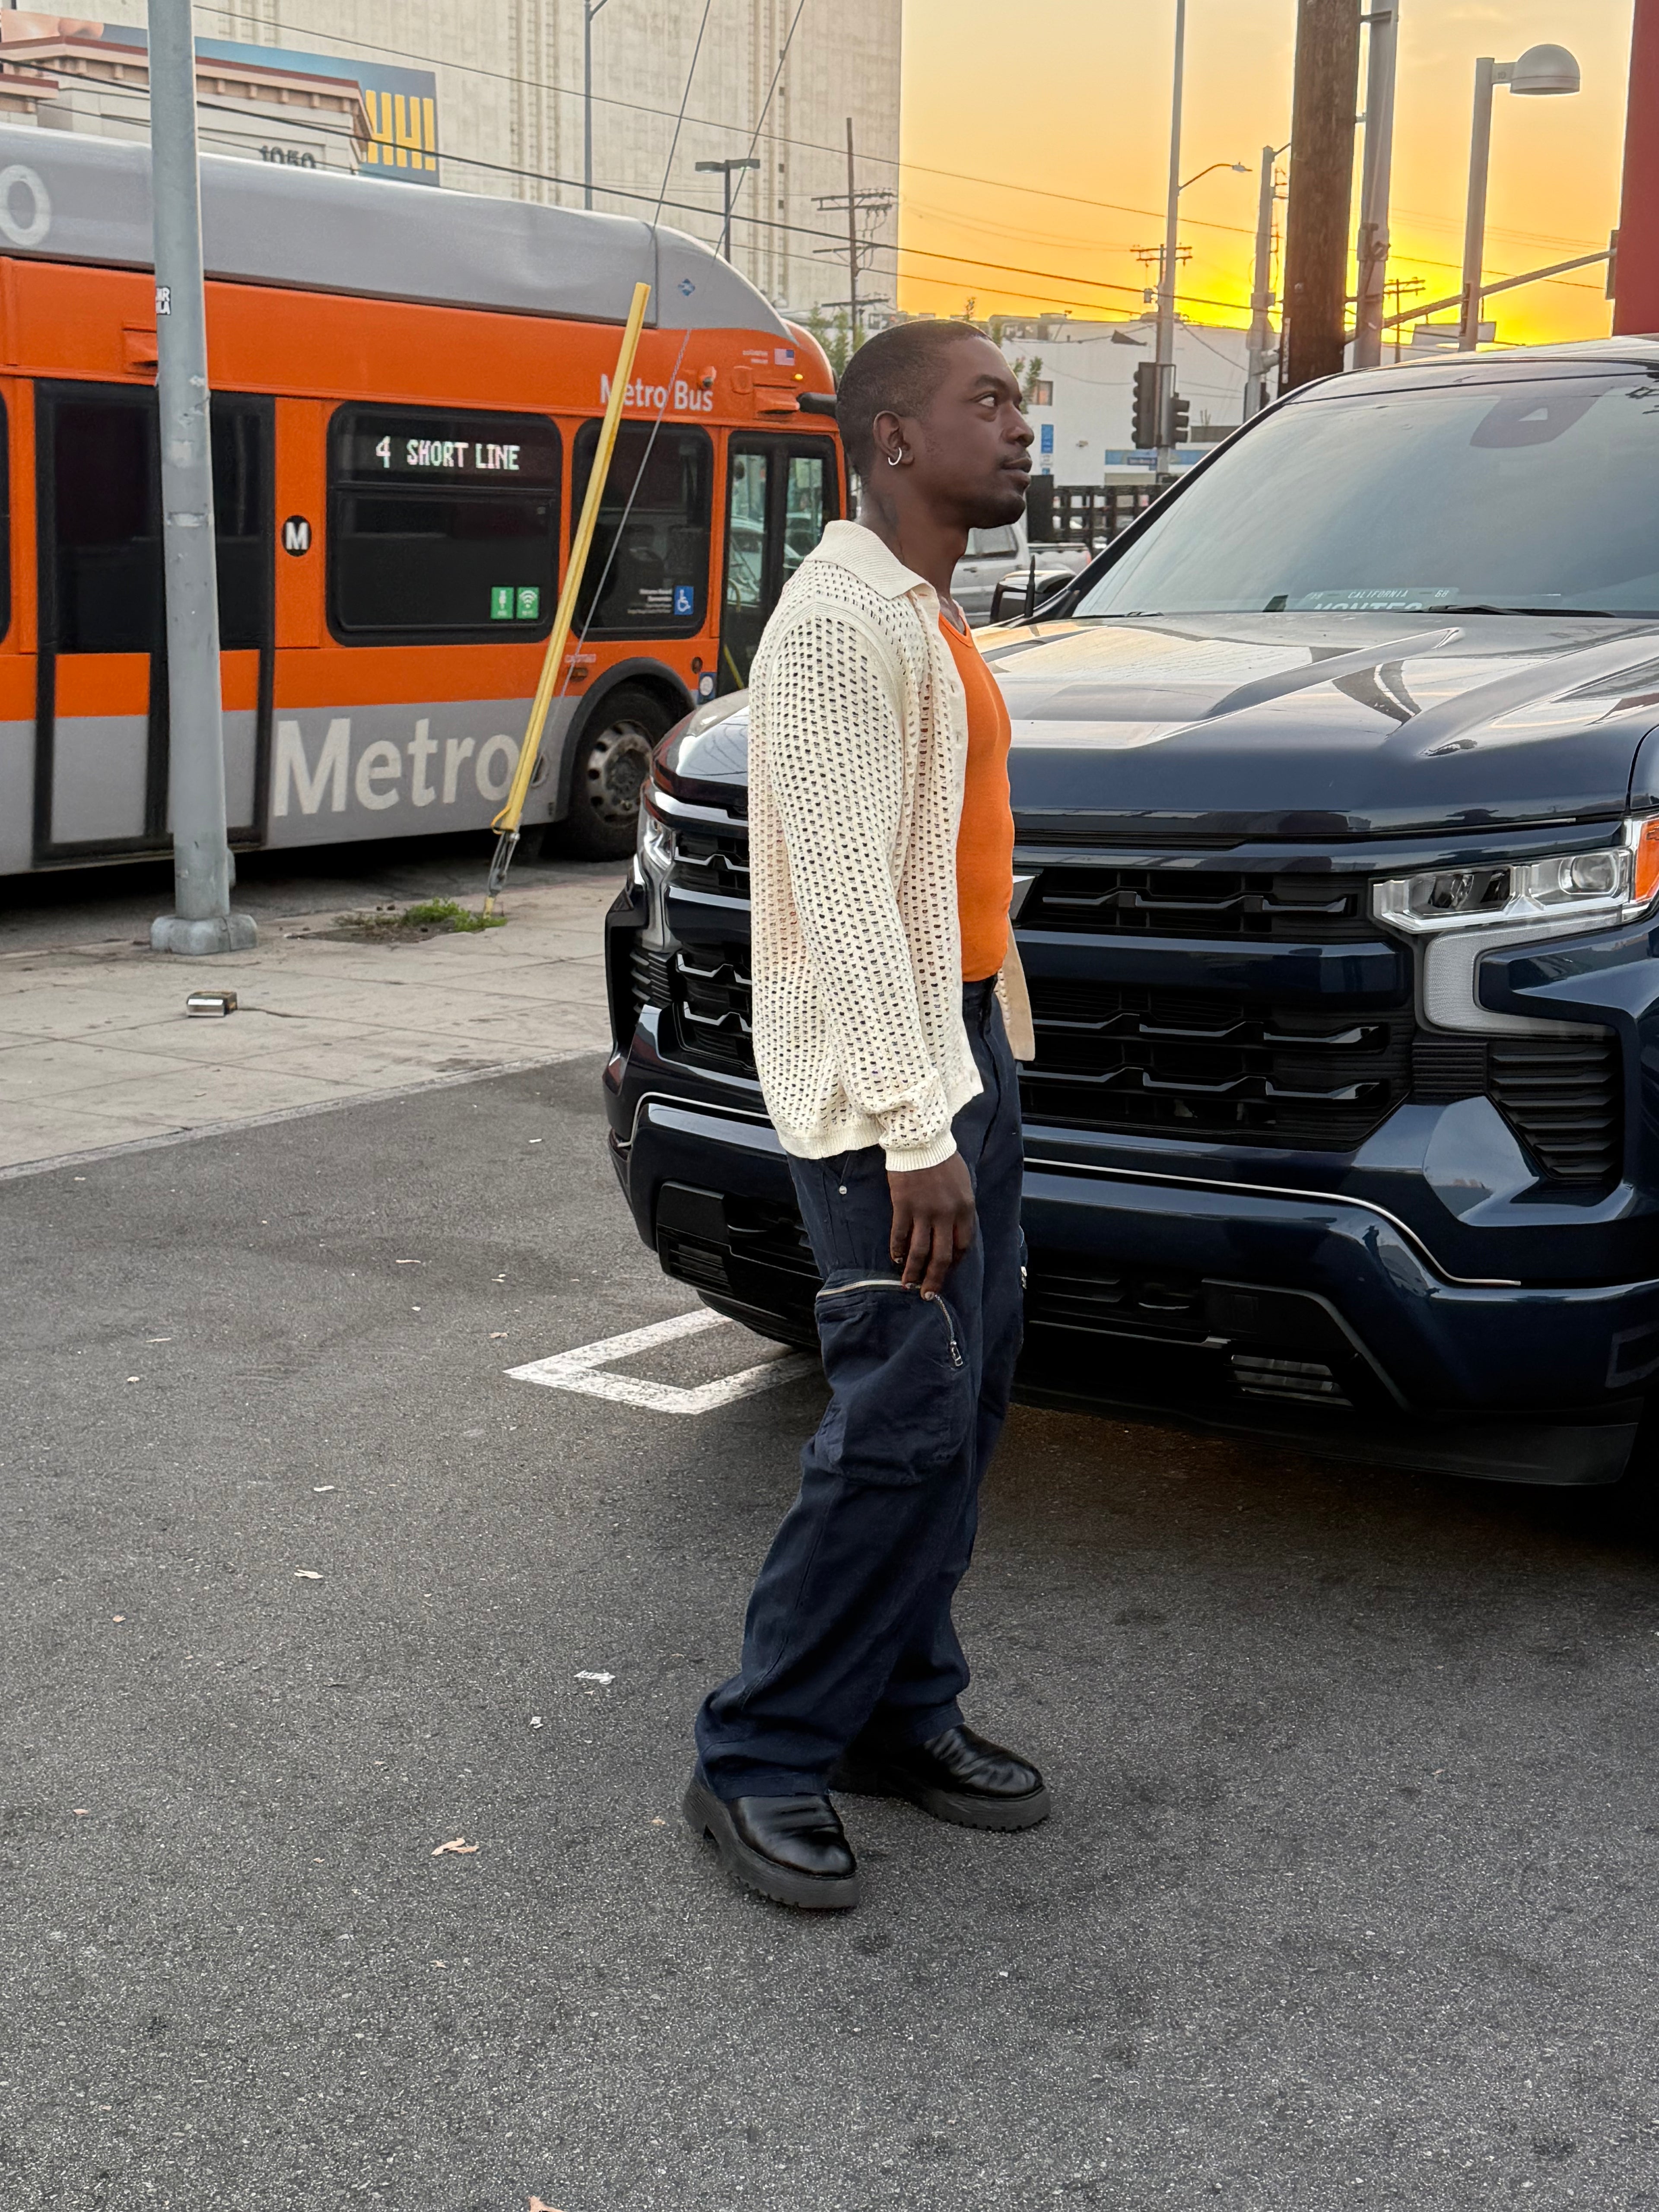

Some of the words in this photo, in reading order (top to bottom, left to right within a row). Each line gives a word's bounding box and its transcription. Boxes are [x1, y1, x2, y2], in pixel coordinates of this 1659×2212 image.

[674, 380, 713, 412] Bus
[376, 435, 391, 468] 4
[407, 439, 469, 467] SHORT
[475, 443, 521, 470] LINE
[286, 522, 308, 550] M
[1348, 590, 1408, 599] CALIFORNIA
[273, 718, 519, 817] Metro
